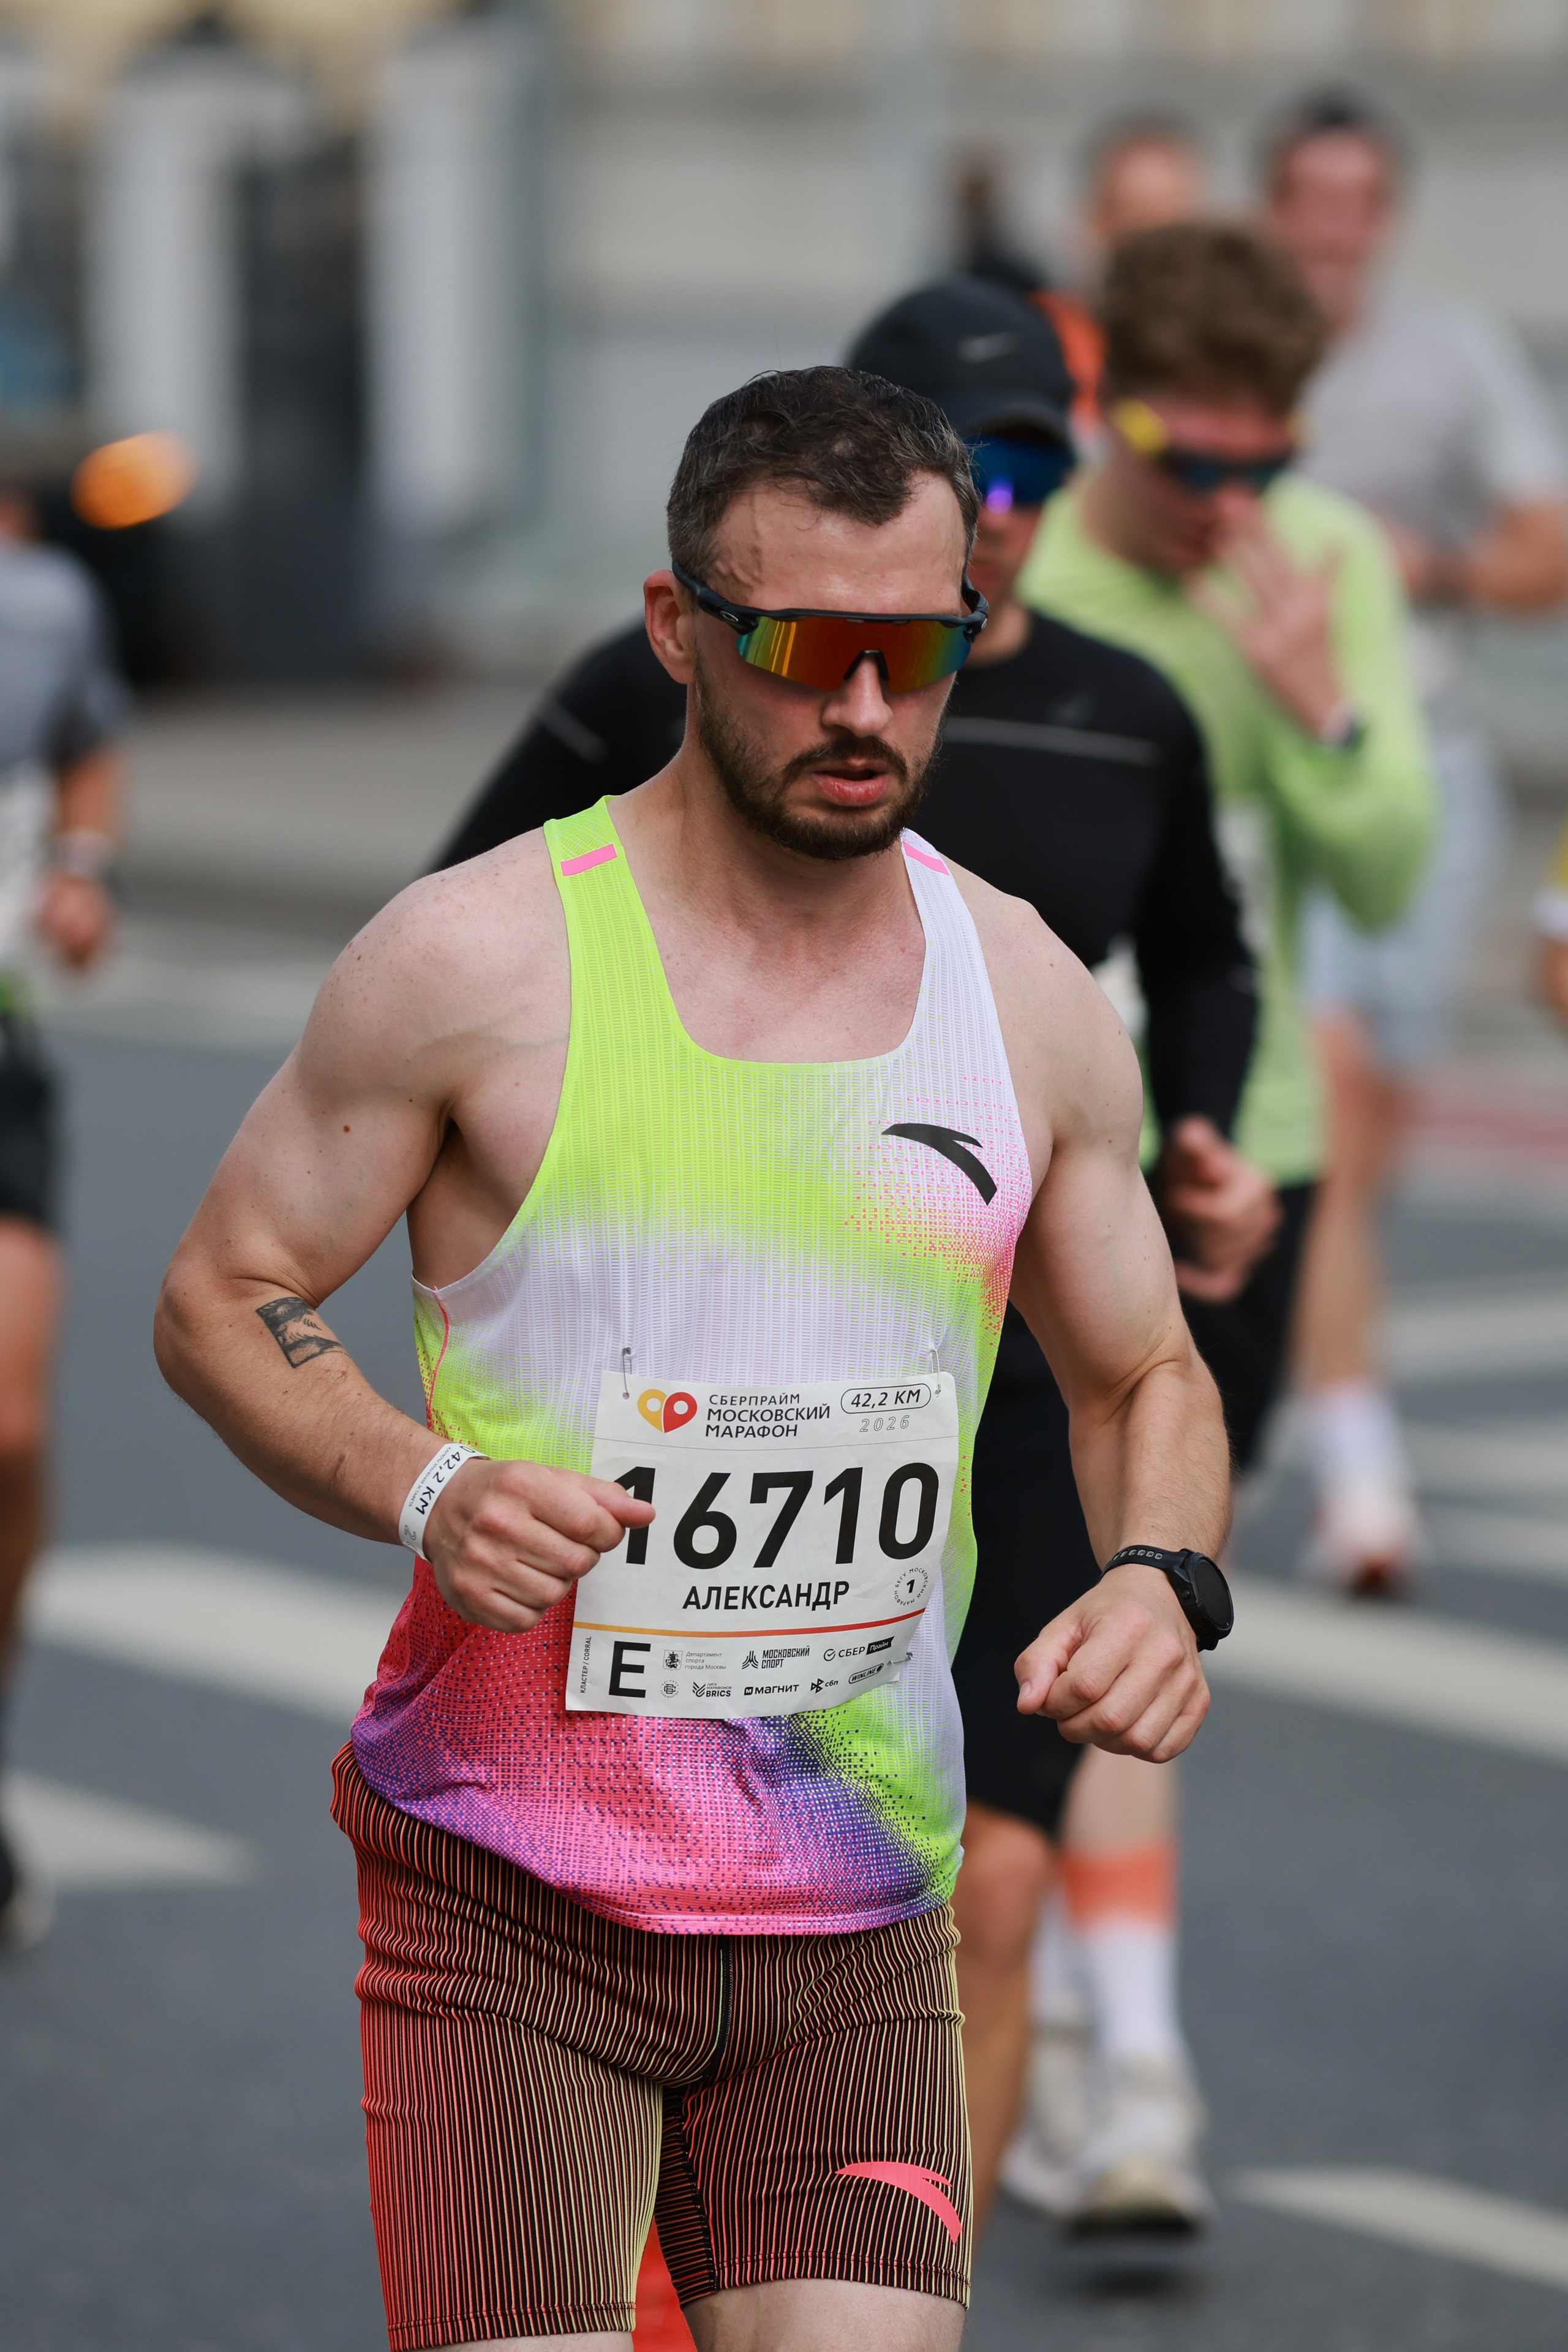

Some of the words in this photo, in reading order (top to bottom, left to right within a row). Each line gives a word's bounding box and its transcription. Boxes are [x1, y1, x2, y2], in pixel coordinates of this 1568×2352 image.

[709, 1392, 800, 1406] СБЕРПРАЙМ
[851, 1392, 888, 1409] 42,2
[707, 1403, 831, 1422] МОСКОВСКИЙ
[705, 1424, 797, 1438] МАРАФОН
[859, 1415, 910, 1433] 2026
[432, 1452, 461, 1483] 42,2
[614, 1462, 939, 1569] 16710
[907, 1579, 915, 1594] 1
[682, 1581, 850, 1611] АЛЕКСАНДР
[763, 1645, 810, 1659] МОСКОВСКИЙ
[839, 1646, 865, 1657] СБЕР
[870, 1642, 889, 1651] Прайм
[761, 1659, 784, 1668] СПОРТ
[851, 1668, 877, 1682] WINLINE
